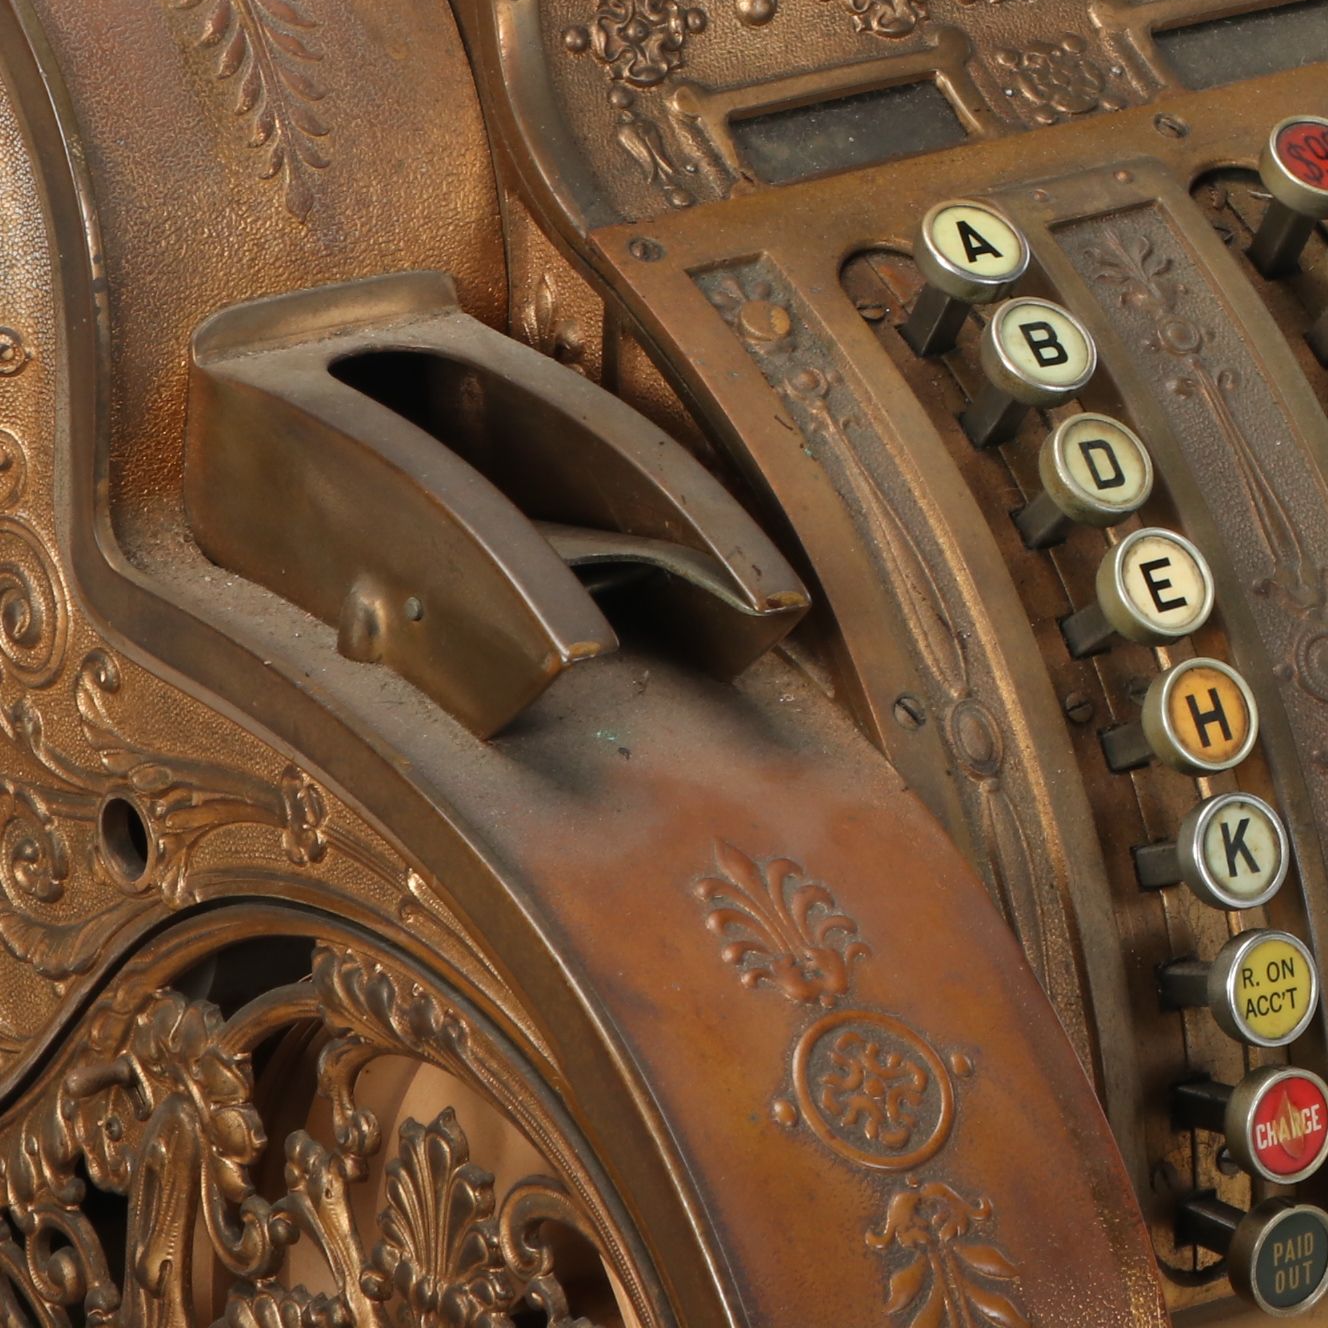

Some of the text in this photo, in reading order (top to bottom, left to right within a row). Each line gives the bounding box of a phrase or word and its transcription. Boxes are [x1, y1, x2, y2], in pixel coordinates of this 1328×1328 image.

[955, 220, 1004, 263] A
[1019, 320, 1070, 368] B
[1078, 439, 1127, 491] D
[1139, 557, 1189, 613] E
[1185, 687, 1235, 749] H
[1219, 818, 1261, 879] K
[1242, 957, 1295, 989] R. ON
[1245, 987, 1298, 1020] ACC'T
[1273, 1232, 1314, 1267] PAID
[1275, 1262, 1313, 1294] OUT
